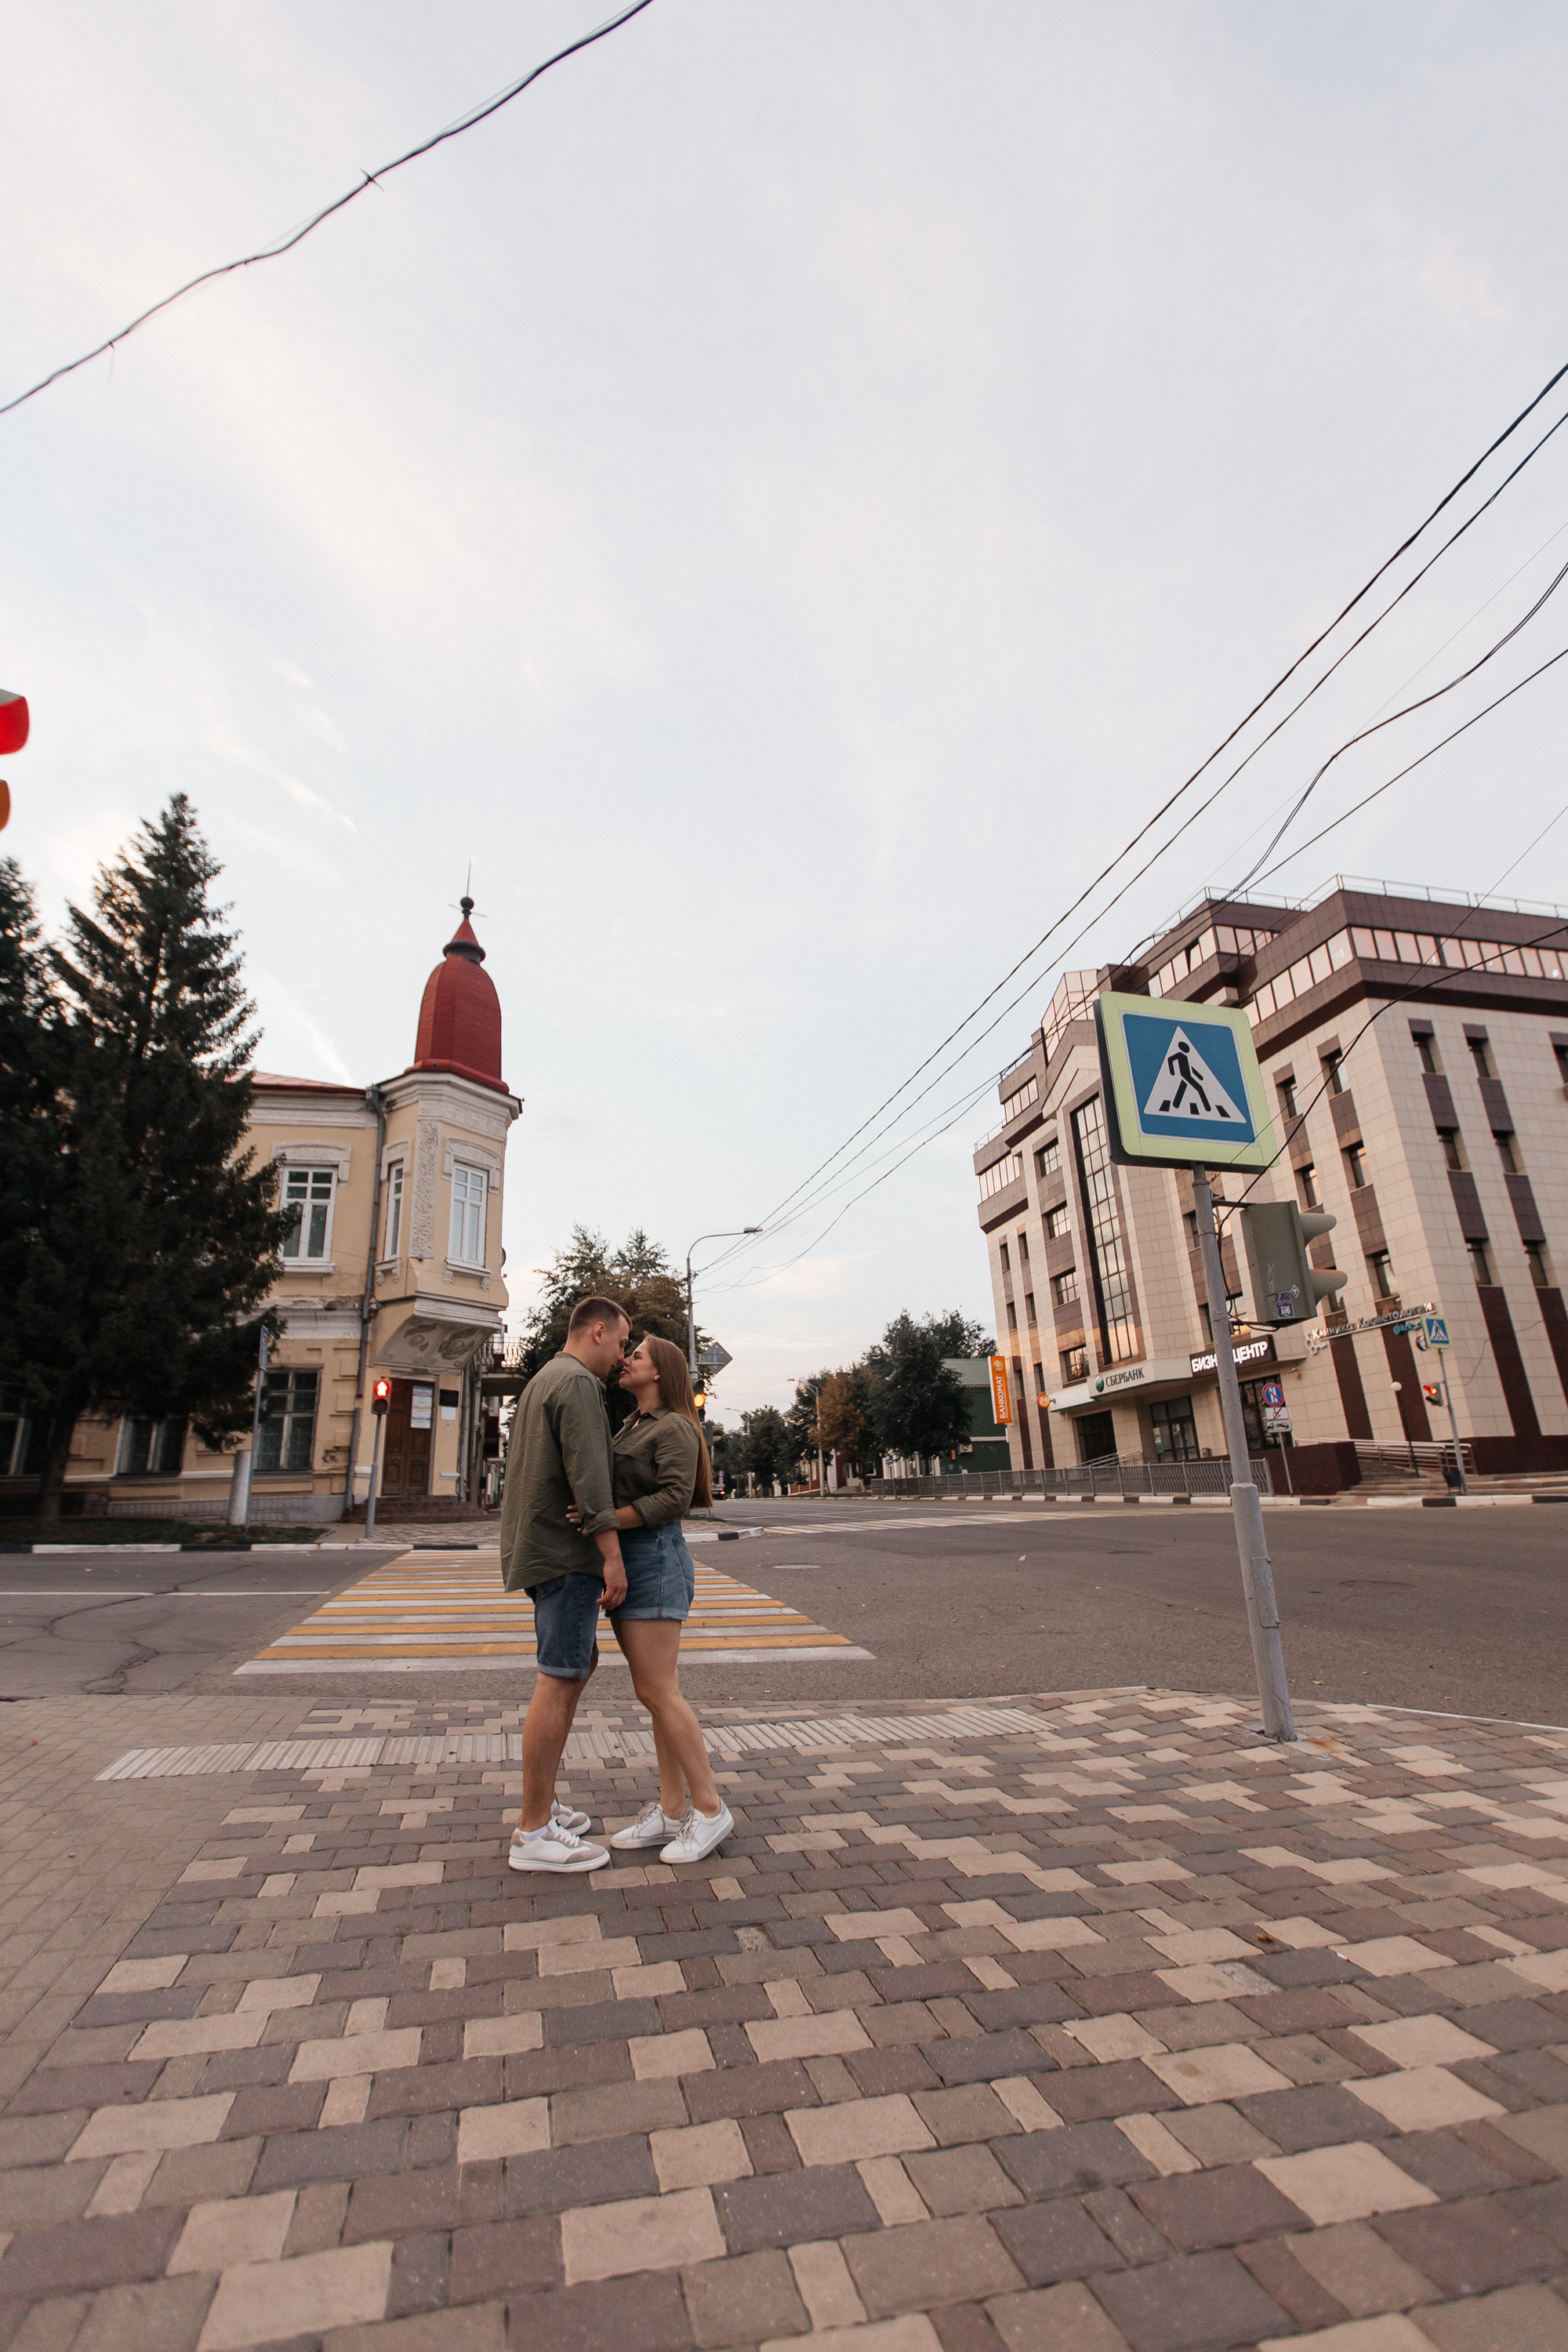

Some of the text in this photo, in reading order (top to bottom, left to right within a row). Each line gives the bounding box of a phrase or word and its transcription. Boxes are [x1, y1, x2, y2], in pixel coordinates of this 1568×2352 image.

[1312, 1323, 1352, 1340] Клиника
[1192, 1341, 1268, 1372] БИЗН ЦЕНТР
[1105, 1367, 1145, 1387] СБЕРБАНК
[996, 1376, 1006, 1419] БАНКОМАТ
